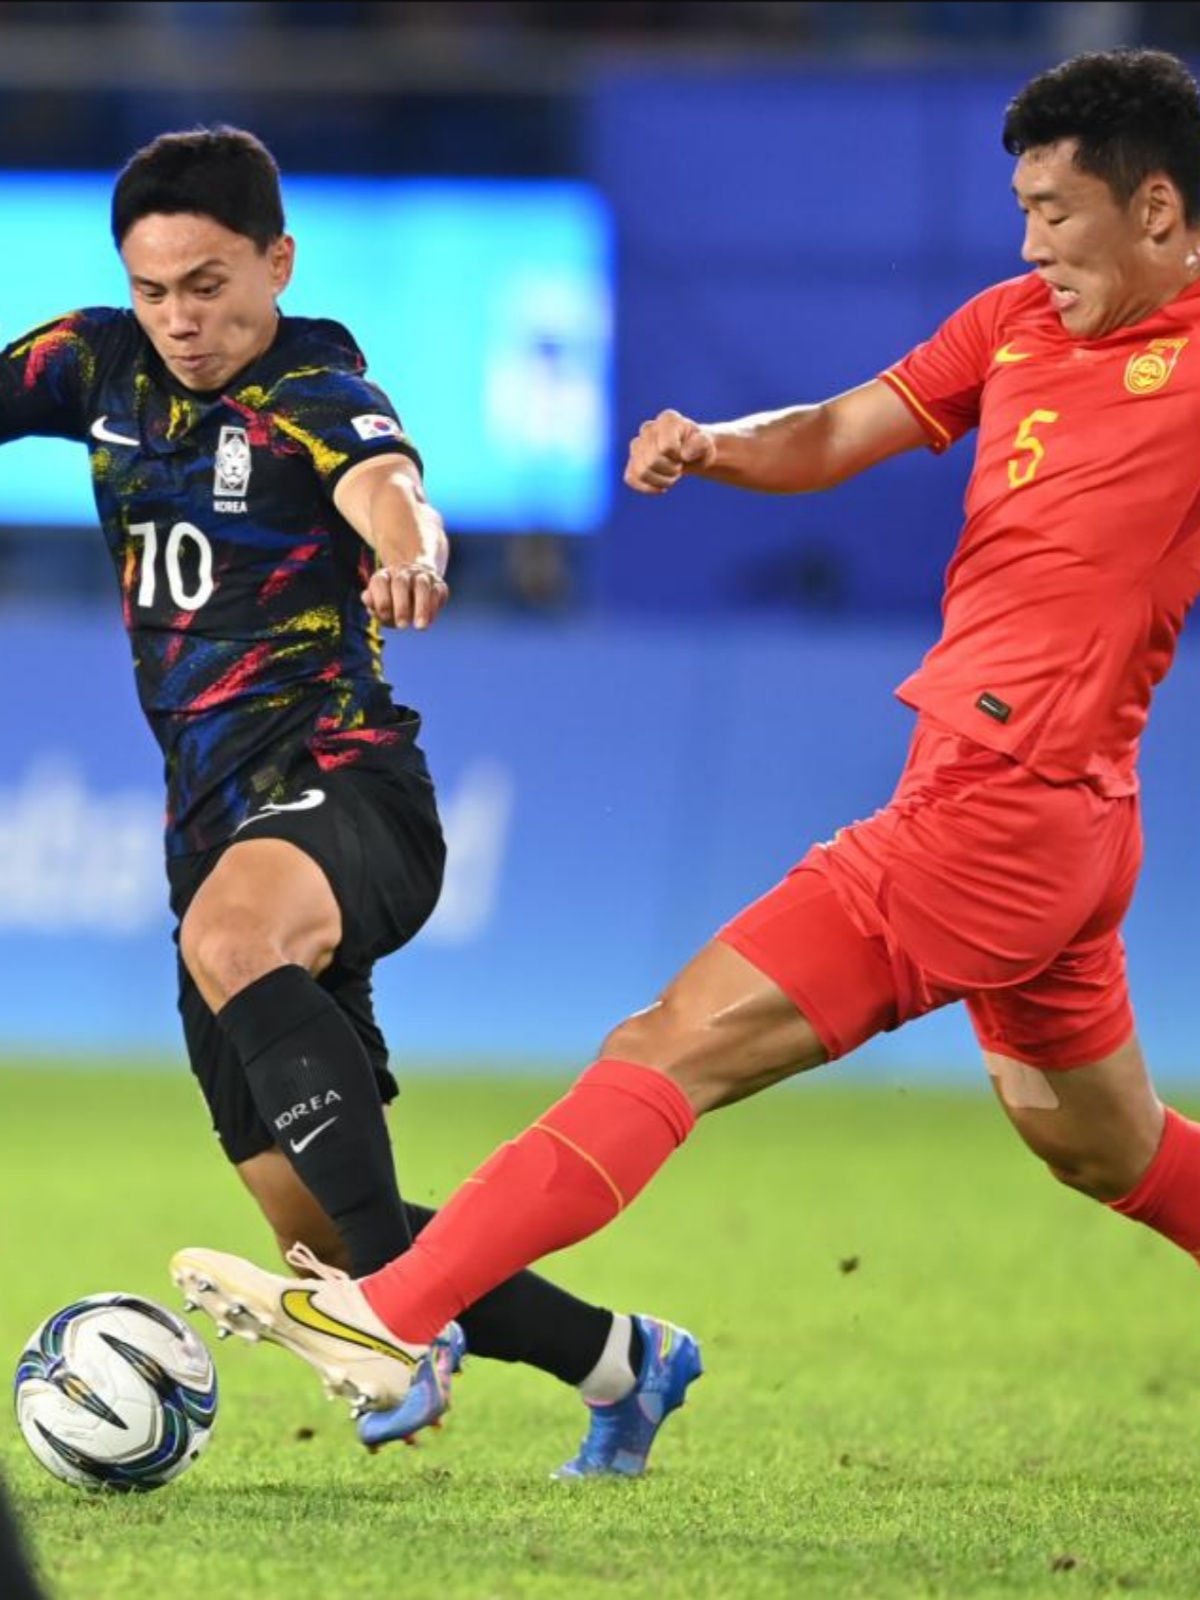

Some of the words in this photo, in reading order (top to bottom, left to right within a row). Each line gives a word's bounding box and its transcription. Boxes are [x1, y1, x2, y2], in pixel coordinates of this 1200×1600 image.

[1007, 408, 1059, 489] 5
[213, 500, 248, 514] KOREA
[128, 521, 215, 611] 10
